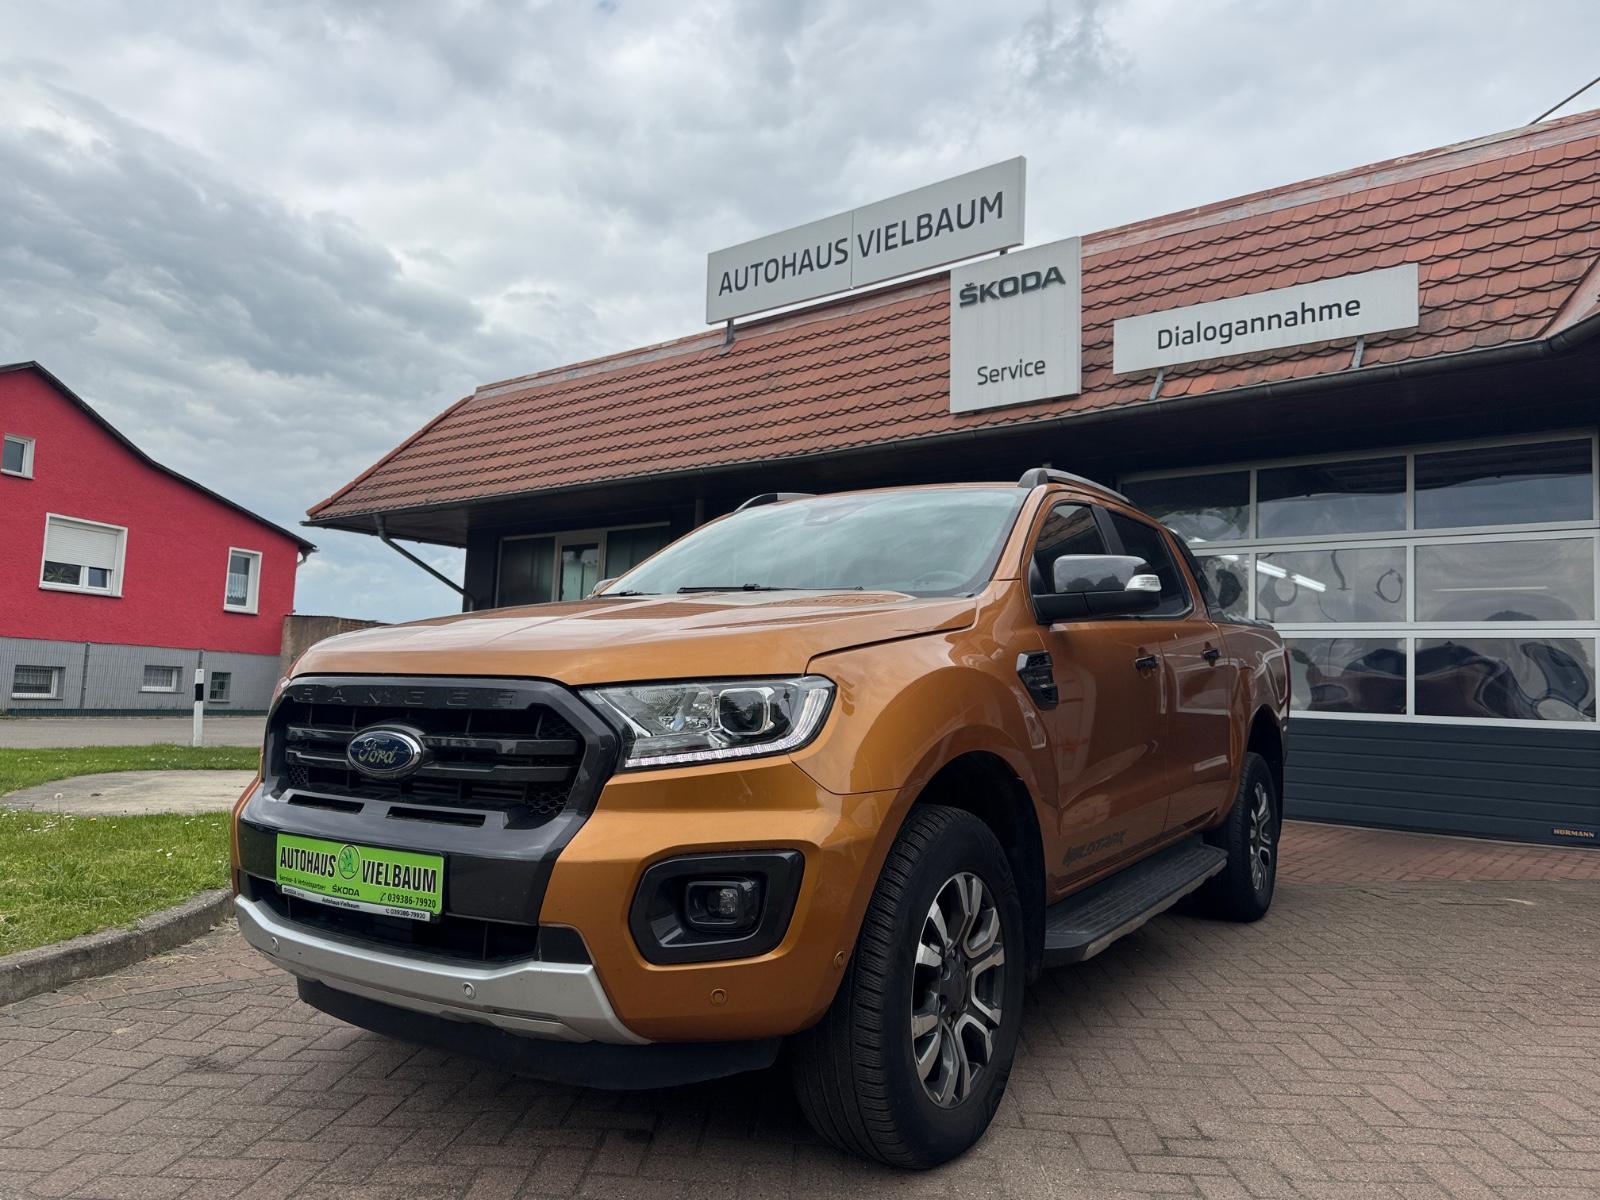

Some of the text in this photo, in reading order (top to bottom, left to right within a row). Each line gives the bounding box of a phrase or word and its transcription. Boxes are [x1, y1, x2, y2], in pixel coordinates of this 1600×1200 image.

[718, 191, 1003, 296] AUTOHAUS VIELBAUM
[959, 266, 1066, 308] ŠKODA
[1157, 299, 1361, 351] Dialogannahme
[977, 358, 1046, 386] Service
[358, 737, 399, 764] Ford
[280, 846, 437, 893] AUTOHAUS VIELBAUM
[332, 884, 360, 897] ŠKODA
[387, 893, 437, 908] 039386-79920
